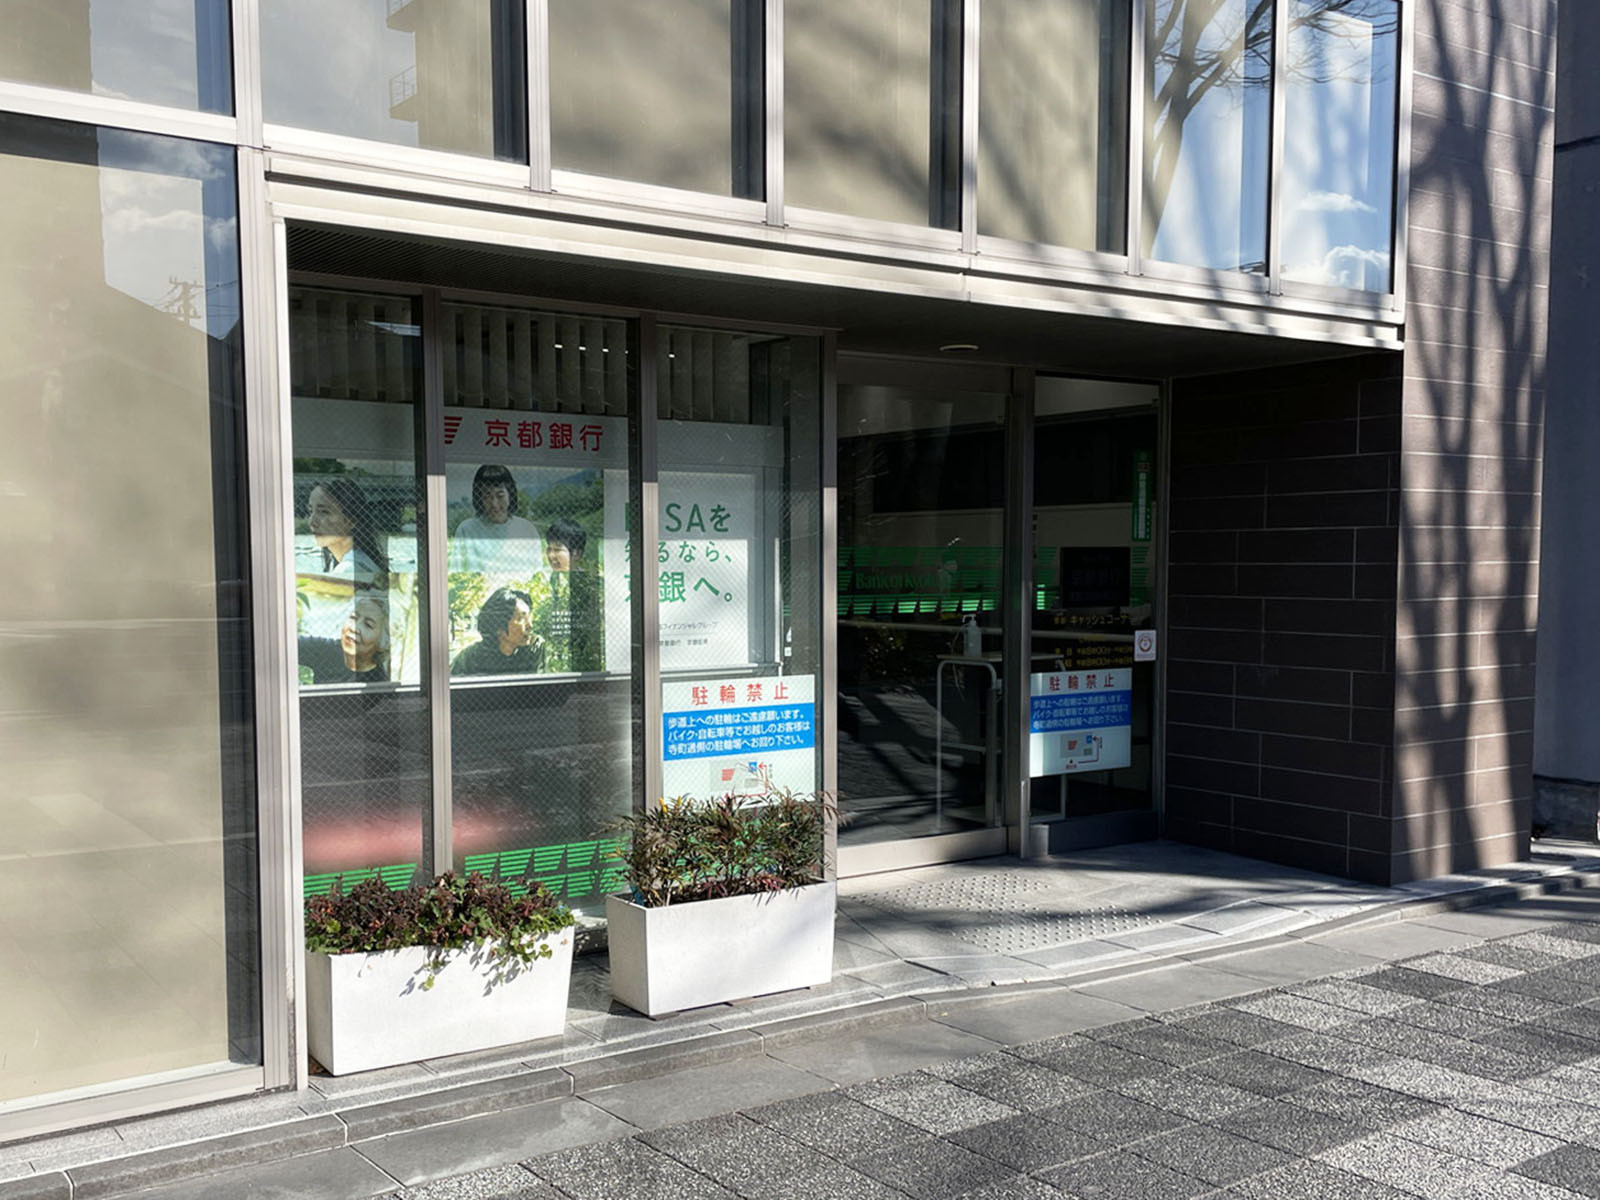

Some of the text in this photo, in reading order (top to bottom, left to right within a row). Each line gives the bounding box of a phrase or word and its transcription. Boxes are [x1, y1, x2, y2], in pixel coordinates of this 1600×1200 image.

[484, 418, 604, 452] 京都銀行
[691, 681, 789, 706] 駐輪禁止
[1049, 673, 1115, 691] 駐輪禁止
